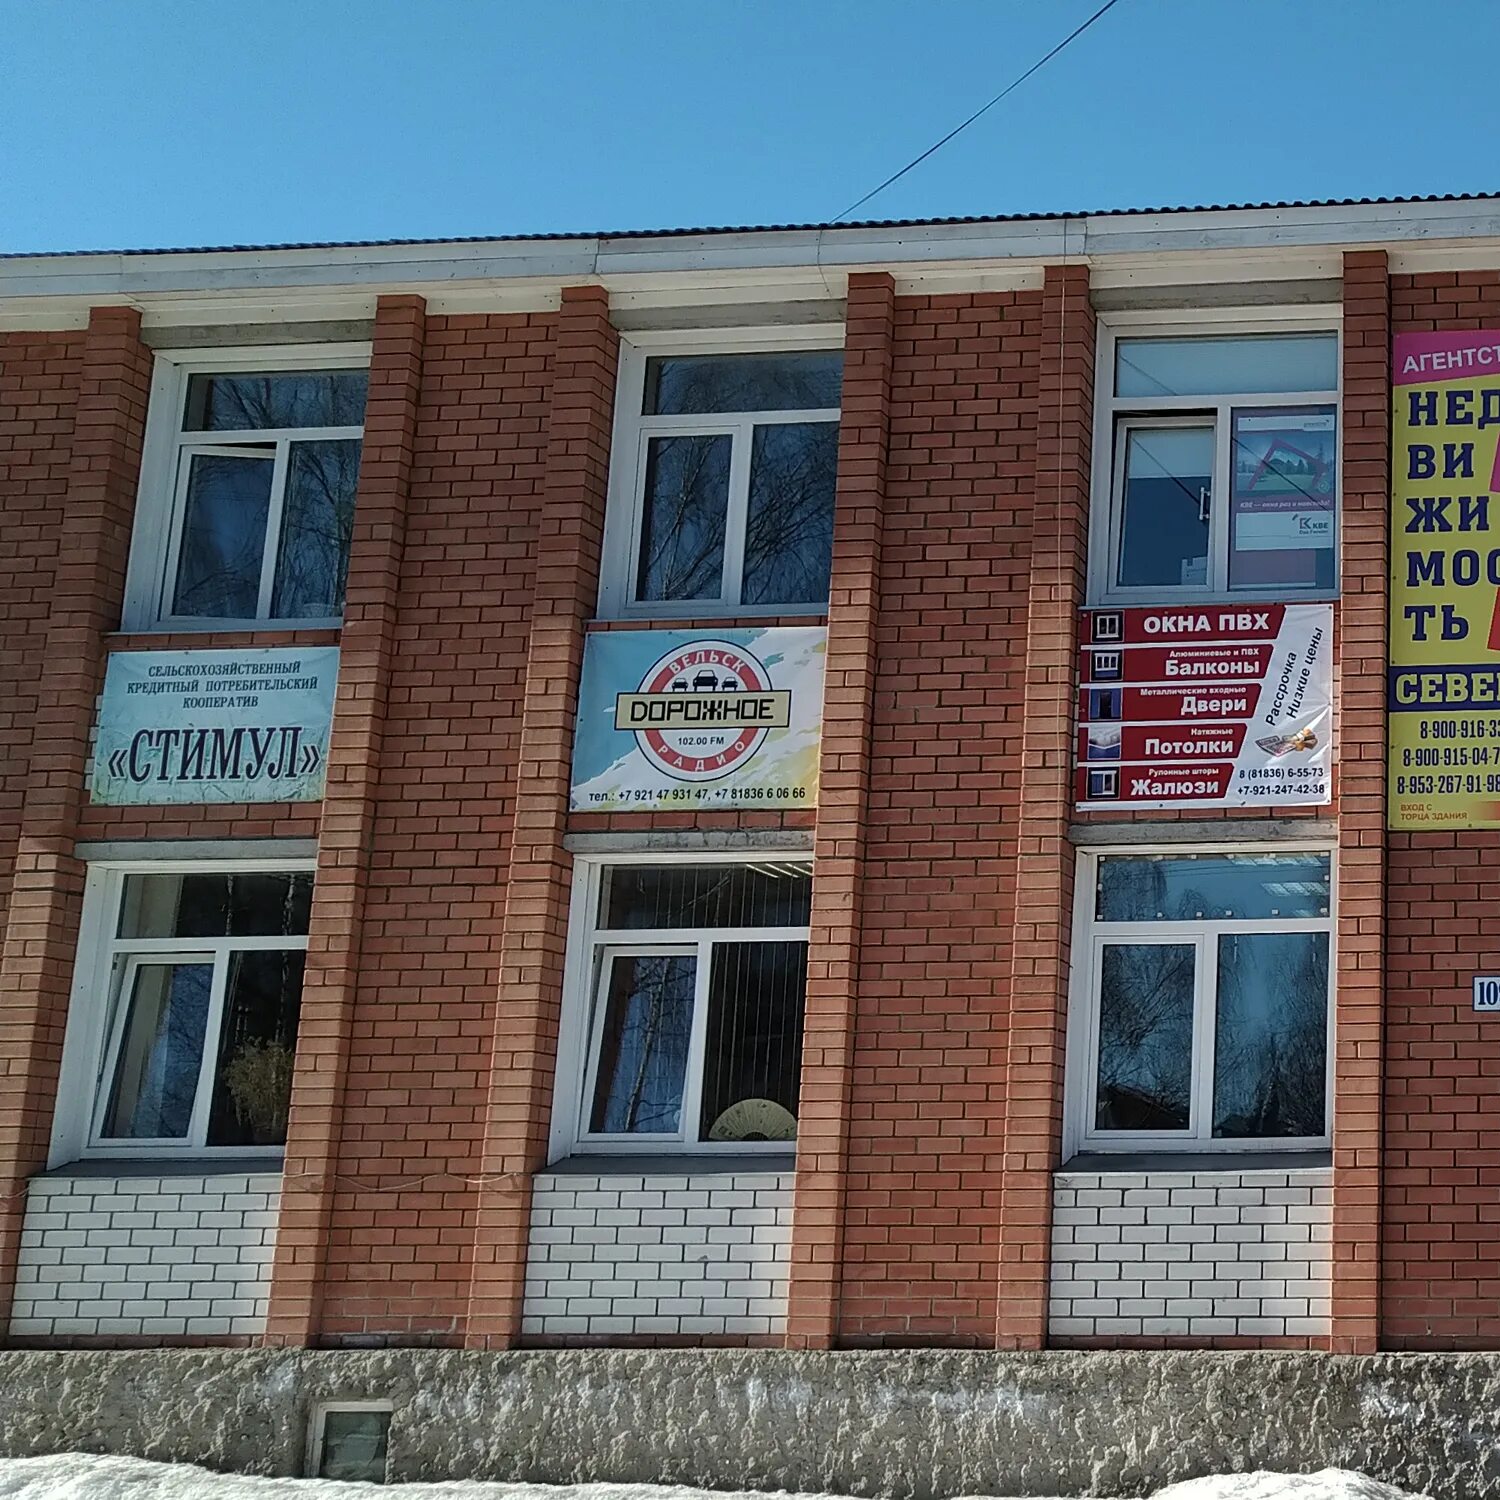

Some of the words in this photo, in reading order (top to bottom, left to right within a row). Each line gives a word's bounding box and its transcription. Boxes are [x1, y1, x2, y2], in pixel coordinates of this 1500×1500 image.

[1408, 443, 1474, 479] ВИ
[1405, 496, 1490, 533] ЖИ
[1143, 615, 1212, 634] ОКНА
[1219, 613, 1270, 631] ПВХ
[1404, 604, 1469, 642] ТЬ
[1169, 649, 1231, 658] Алюминиевые
[148, 661, 301, 677] СЕЛЬСКОХОЗЯЙСТВЕННЫЙ
[668, 651, 746, 674] ВЕЛЬСК
[1165, 659, 1260, 676] Балконы
[1286, 668, 1311, 719] Низкие
[1308, 627, 1324, 666] цены
[127, 679, 200, 694] КРЕДИТНЫЙ
[205, 676, 318, 691] ПОТРЕБИТЕЛЬСКИЙ
[1140, 688, 1207, 696] Металлические
[1209, 686, 1246, 695] входные
[1265, 651, 1298, 727] Рассрочка
[182, 695, 259, 709] КООПЕРАТИВ
[1181, 696, 1247, 715] Двери
[1191, 728, 1233, 736] Натяжные
[677, 737, 708, 746] 102.00
[710, 736, 725, 745] FM
[1145, 738, 1233, 755] Потолки
[108, 726, 321, 783] «СТИМУЛ»
[658, 740, 746, 773] РАДИО
[1148, 768, 1190, 777] Рулонные
[1191, 767, 1219, 775] шторы
[1239, 770, 1245, 779] 8
[1248, 768, 1285, 780] (81836)
[1287, 767, 1324, 777] 6-55-73
[589, 792, 615, 802] тел.:
[618, 790, 631, 801] +7
[634, 790, 653, 800] 921
[656, 790, 670, 800] 47
[672, 789, 691, 799] 931
[714, 789, 729, 799] +7
[730, 788, 764, 799] 81836
[766, 788, 773, 798] 6
[776, 788, 790, 798] 06
[792, 787, 806, 798] 66
[1131, 779, 1219, 796] Жалюзи
[1238, 784, 1325, 795] +7-921-247-42-38
[1401, 804, 1424, 812] ВХОД
[1432, 812, 1467, 820] ЗДАНИЯ
